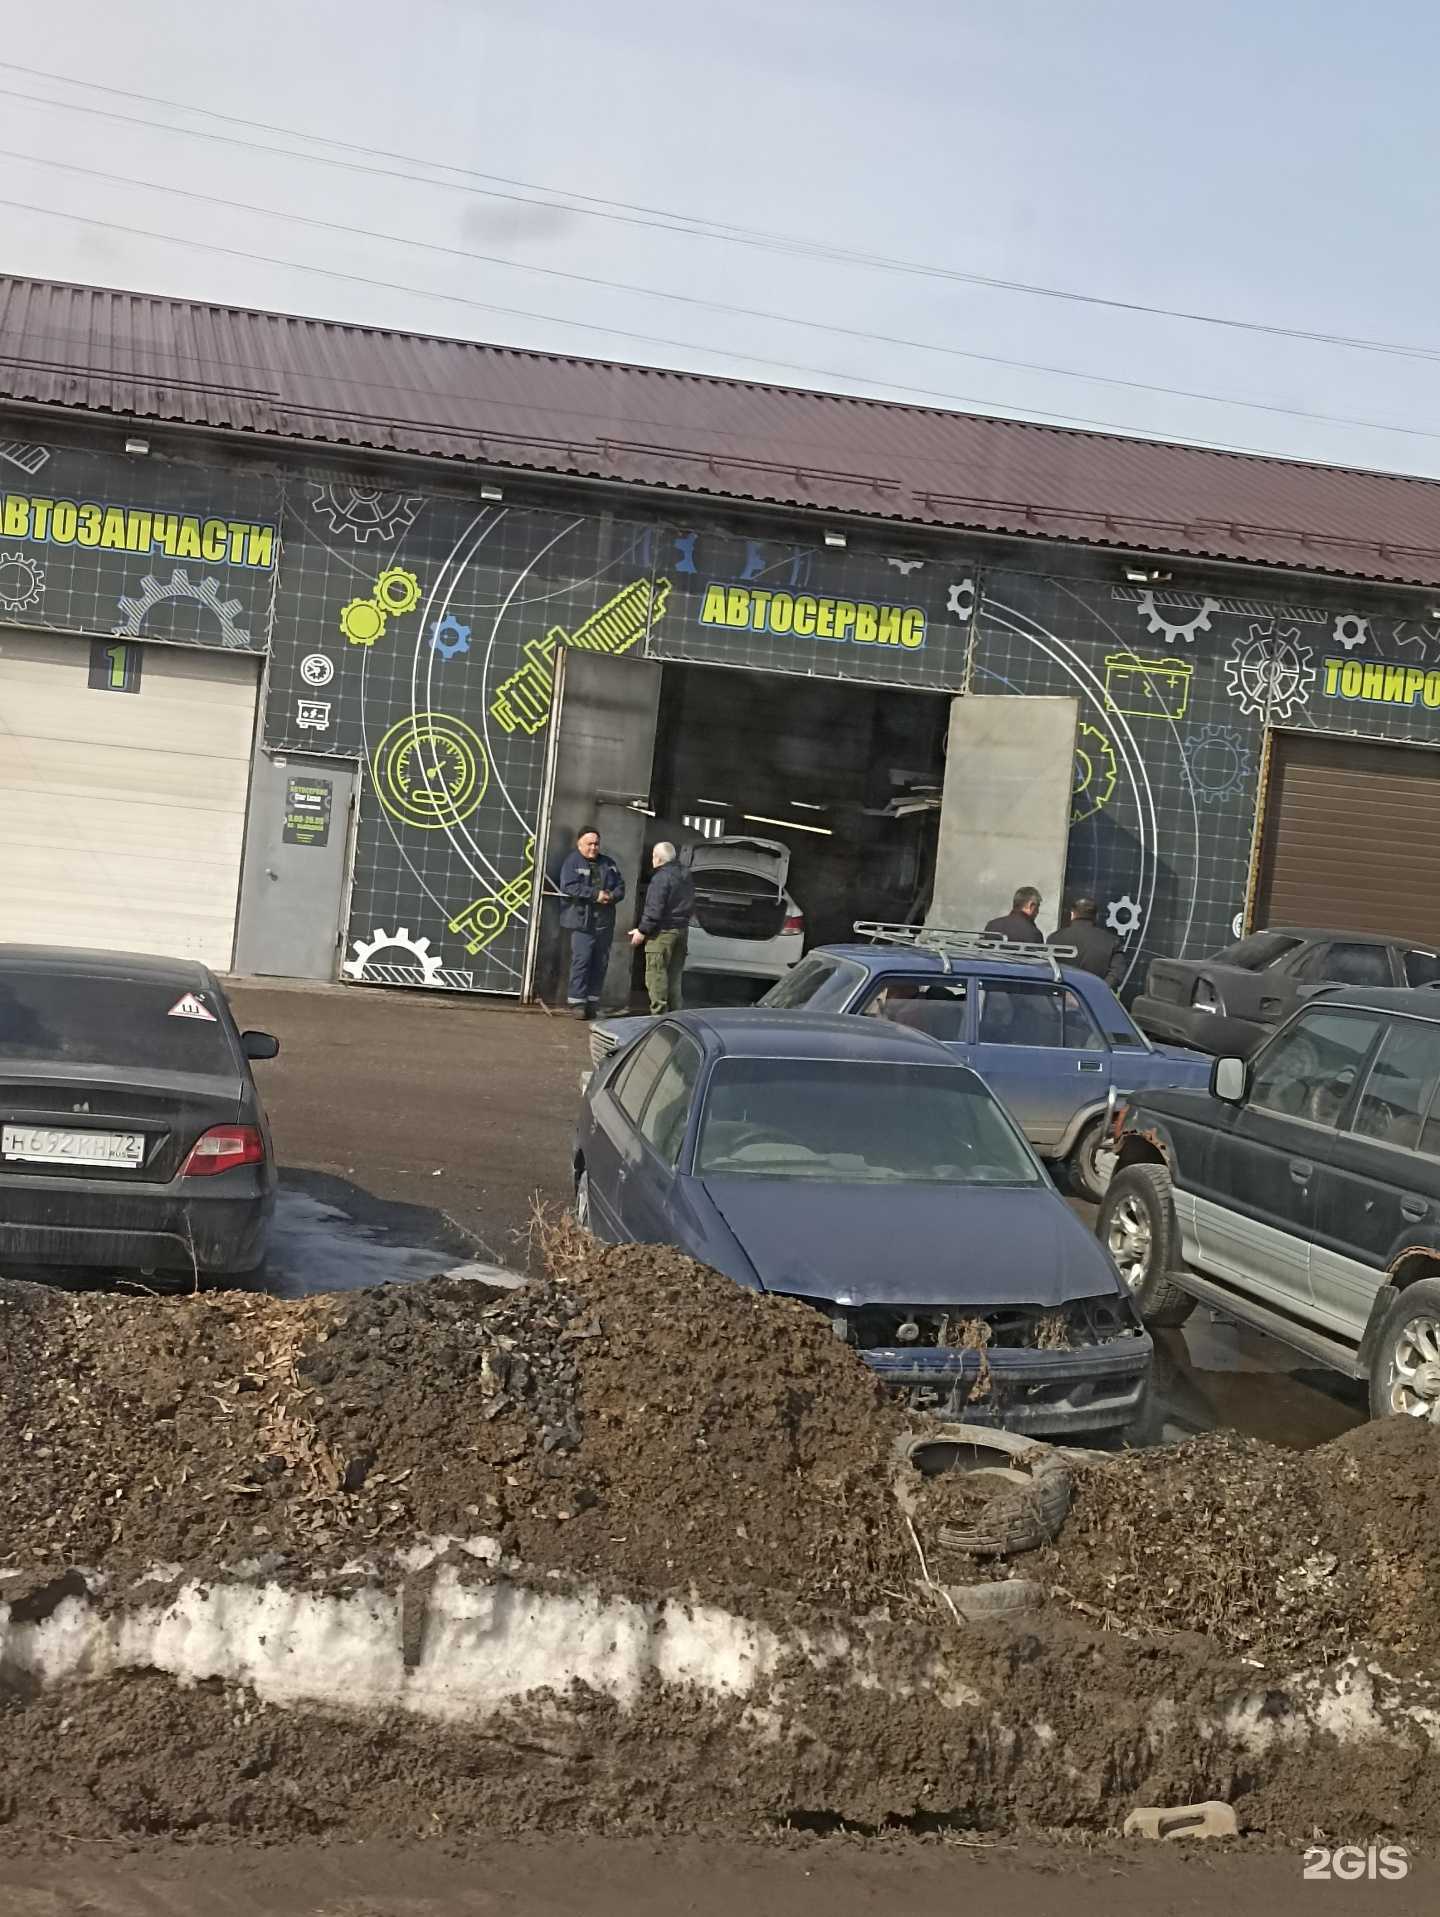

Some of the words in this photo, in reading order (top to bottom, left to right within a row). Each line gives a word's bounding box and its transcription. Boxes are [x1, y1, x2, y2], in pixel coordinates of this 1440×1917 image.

[0, 493, 274, 568] ВТОЗАПЧАСТИ
[701, 583, 926, 649] АВТОСЕРВИС
[105, 645, 128, 689] 1
[1323, 657, 1440, 709] ТОНИРО
